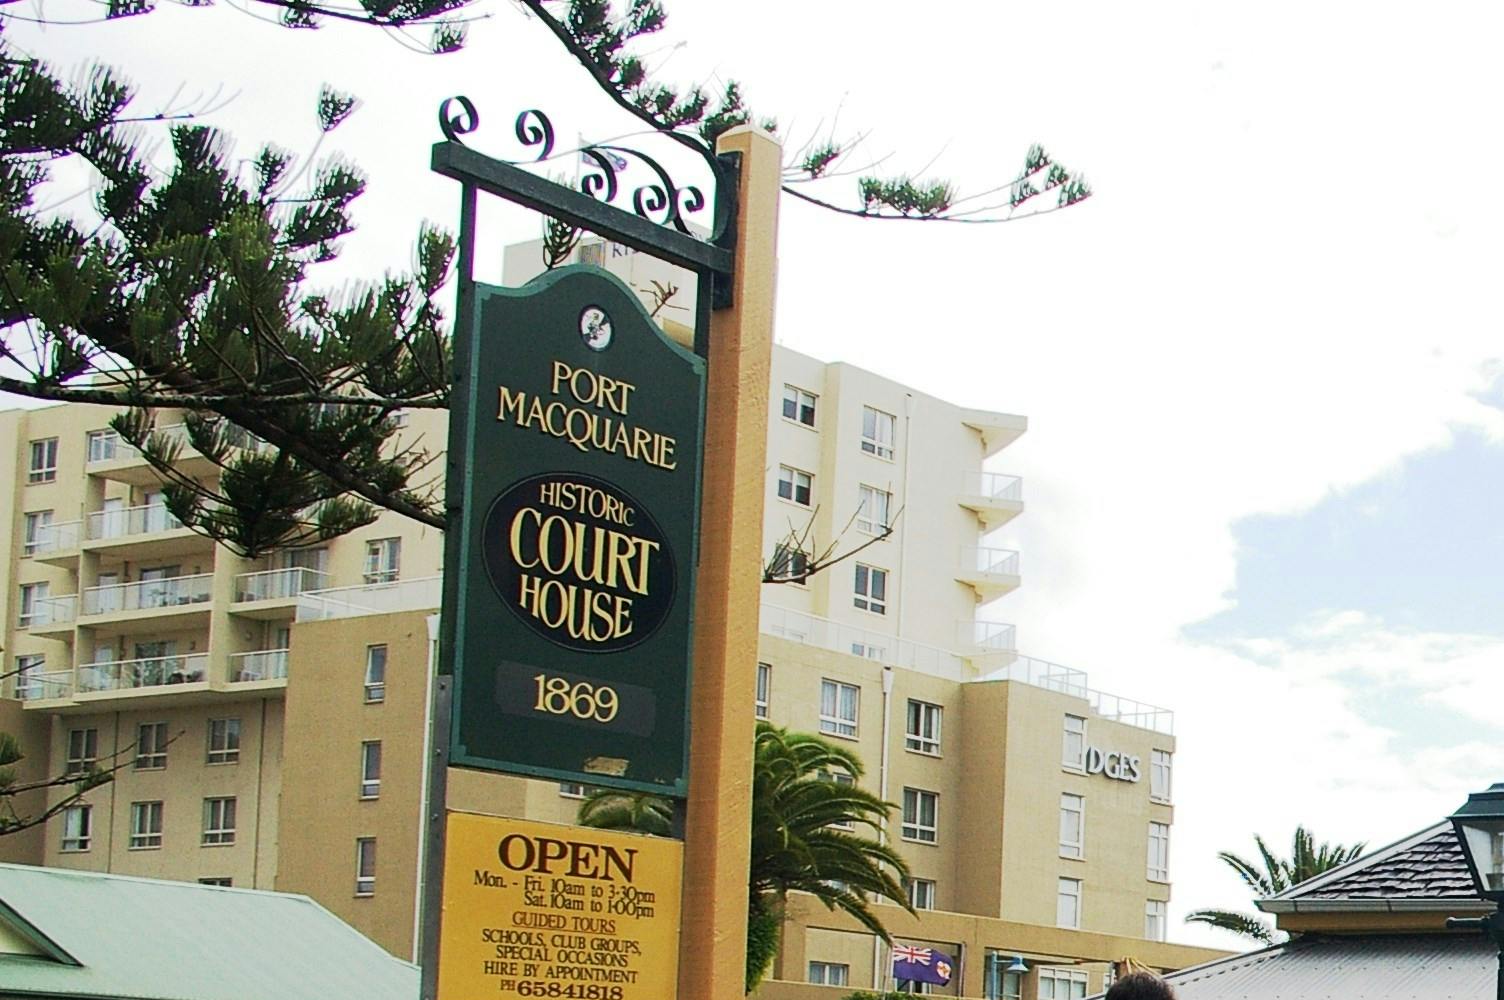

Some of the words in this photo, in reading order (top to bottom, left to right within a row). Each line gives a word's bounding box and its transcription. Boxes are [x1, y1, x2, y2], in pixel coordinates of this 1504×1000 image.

[552, 360, 636, 416] PORT
[497, 385, 677, 471] MACQUARIE
[540, 482, 635, 527] HISTORIC
[510, 507, 660, 596] COURT
[519, 574, 633, 642] HOUSE
[533, 674, 619, 723] 1869
[498, 834, 639, 883] OPEN
[474, 870, 507, 888] Mon.
[524, 875, 545, 892] Fri.
[550, 878, 585, 896] 10am
[591, 885, 603, 898] to
[524, 891, 547, 908] Sat.
[550, 893, 584, 911] 10am
[590, 900, 602, 913] to
[512, 911, 567, 929] GUIDED
[571, 916, 617, 933] TOURS
[482, 928, 546, 947] SCHOOLS,
[551, 934, 586, 949] CLUB
[590, 937, 642, 956] GROUPS,
[496, 944, 552, 962] SPECIAL
[557, 949, 628, 967] OCCASIONS
[483, 960, 518, 976] HIRE
[523, 965, 540, 978] BY
[545, 966, 639, 984] APPOINTMENT
[500, 979, 516, 991] PH
[517, 980, 624, 1000] 65841818
